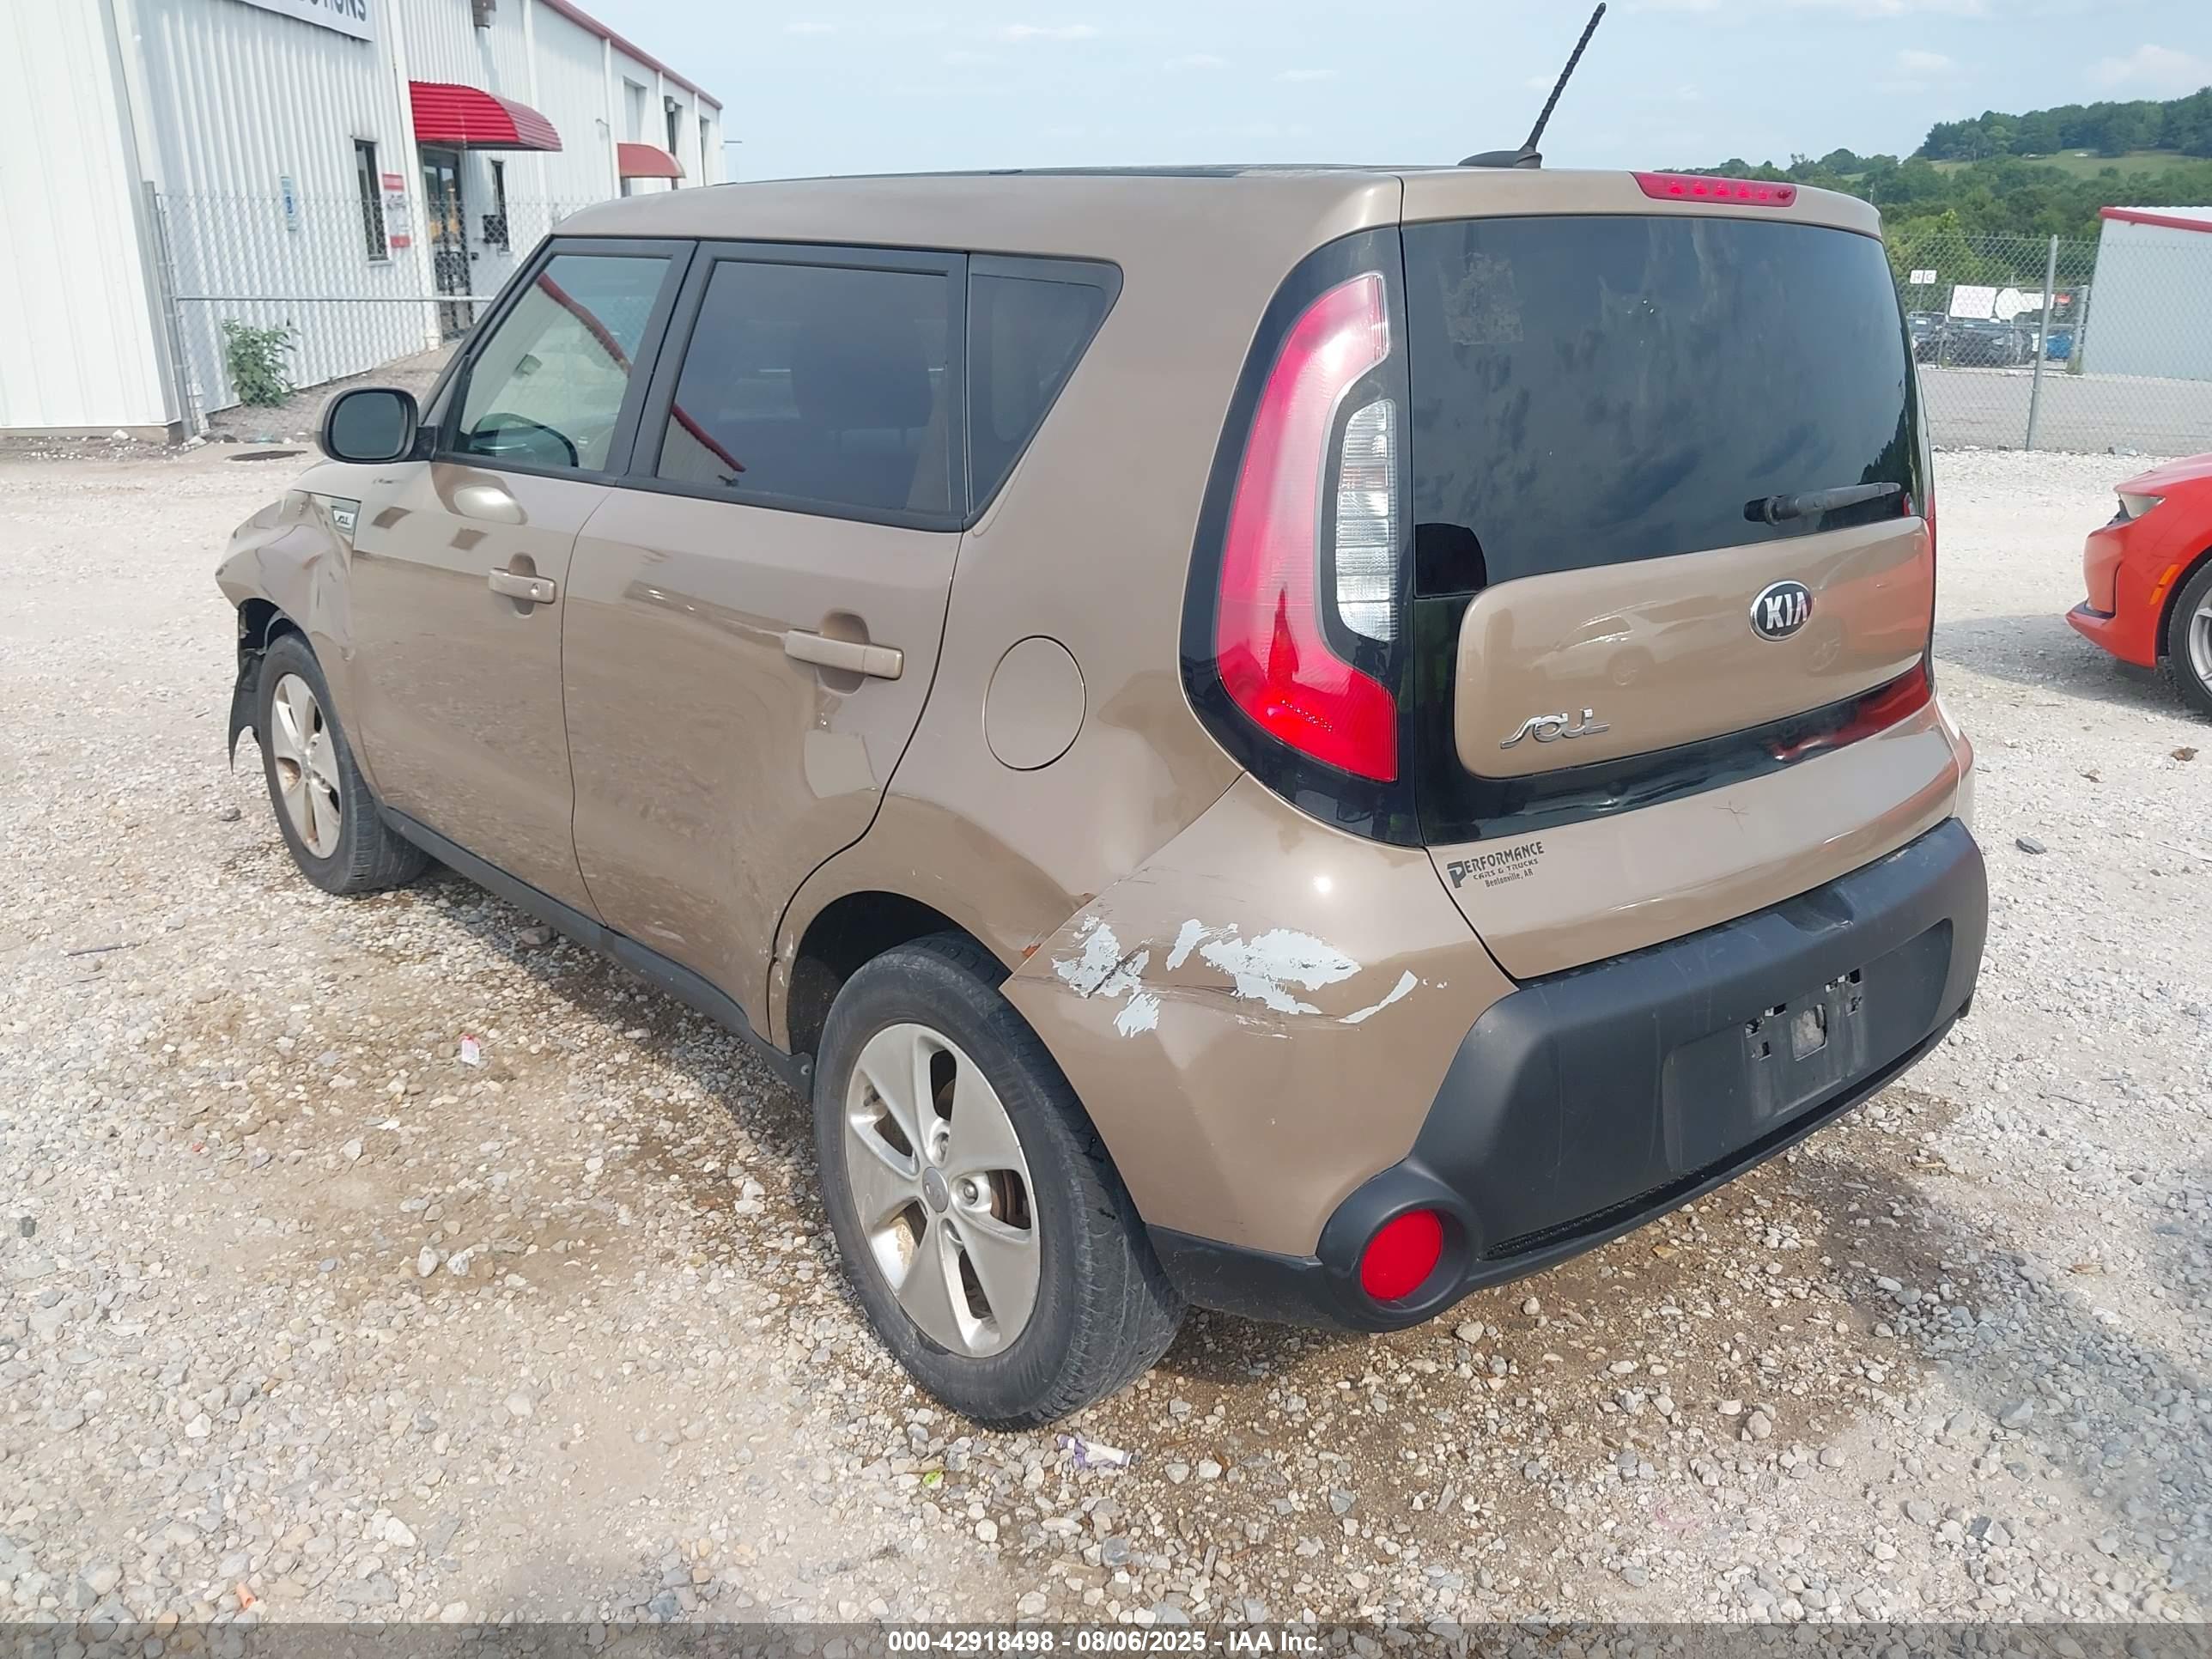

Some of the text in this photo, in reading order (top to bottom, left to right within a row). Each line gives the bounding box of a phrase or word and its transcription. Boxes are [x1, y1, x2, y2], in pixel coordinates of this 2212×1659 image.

[1764, 591, 1808, 630] KIA
[1499, 708, 1611, 749] SOUL
[1447, 842, 1545, 889] PERFORMANCE
[1473, 870, 1496, 880] CARS
[1506, 858, 1539, 871] TRUCKS
[1485, 868, 1534, 888] Bentonville, AR
